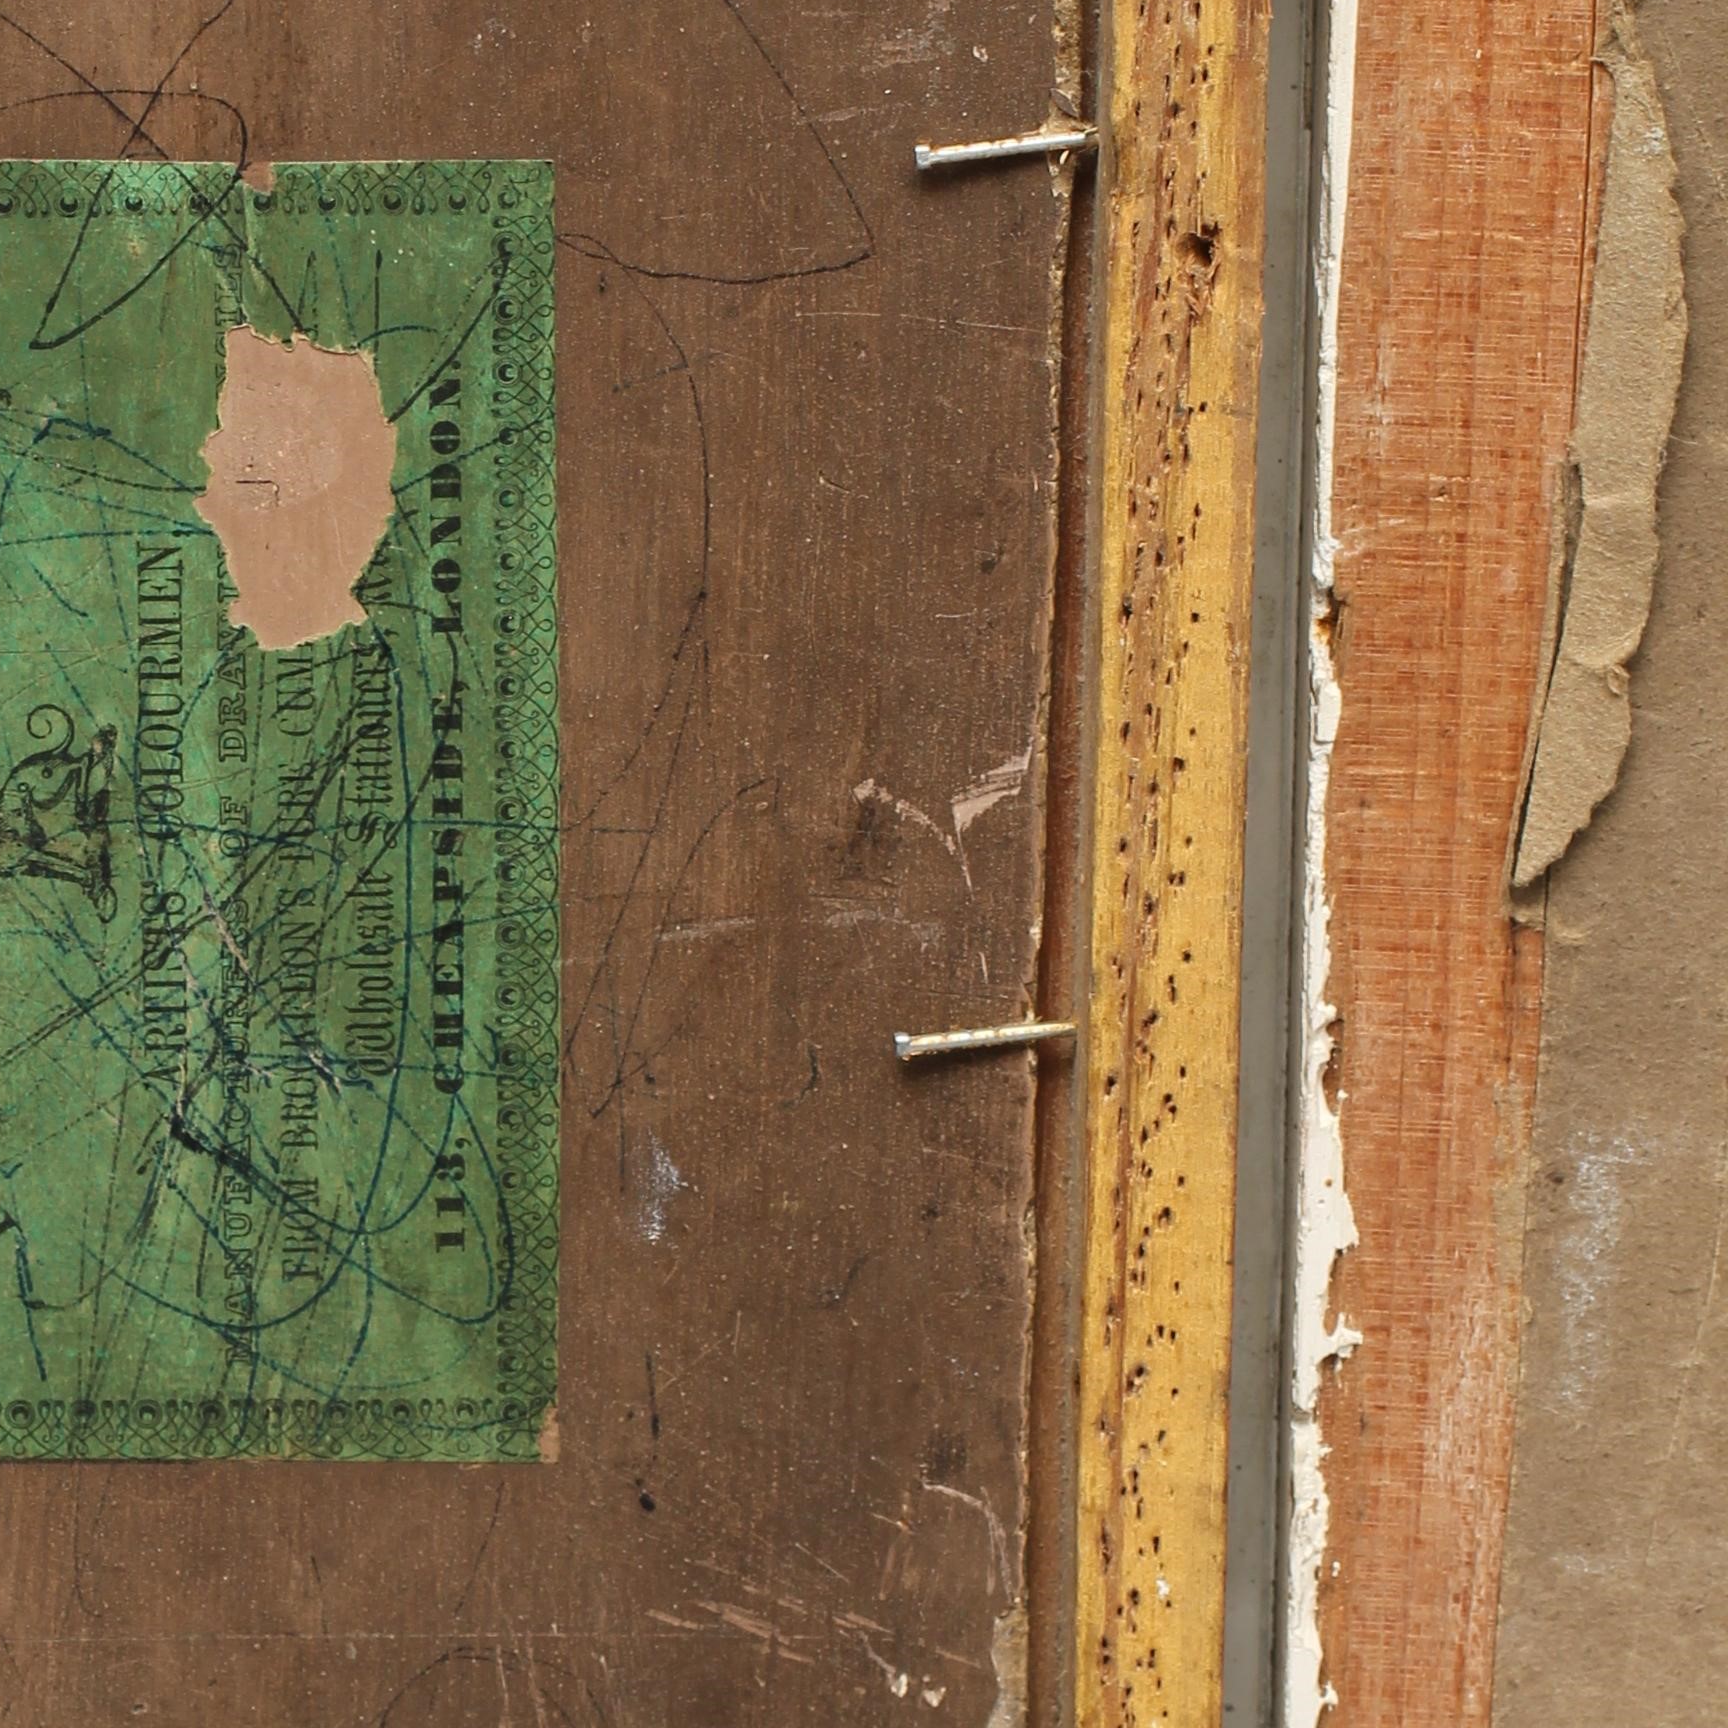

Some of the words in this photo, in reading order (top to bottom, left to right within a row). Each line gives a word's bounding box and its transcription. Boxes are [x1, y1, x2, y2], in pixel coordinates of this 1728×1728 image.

[427, 356, 464, 636] LONDON.
[217, 794, 251, 858] OF
[218, 895, 253, 1364] MANUFACTURERS
[280, 1175, 320, 1280] FROM
[433, 1135, 472, 1254] 113,
